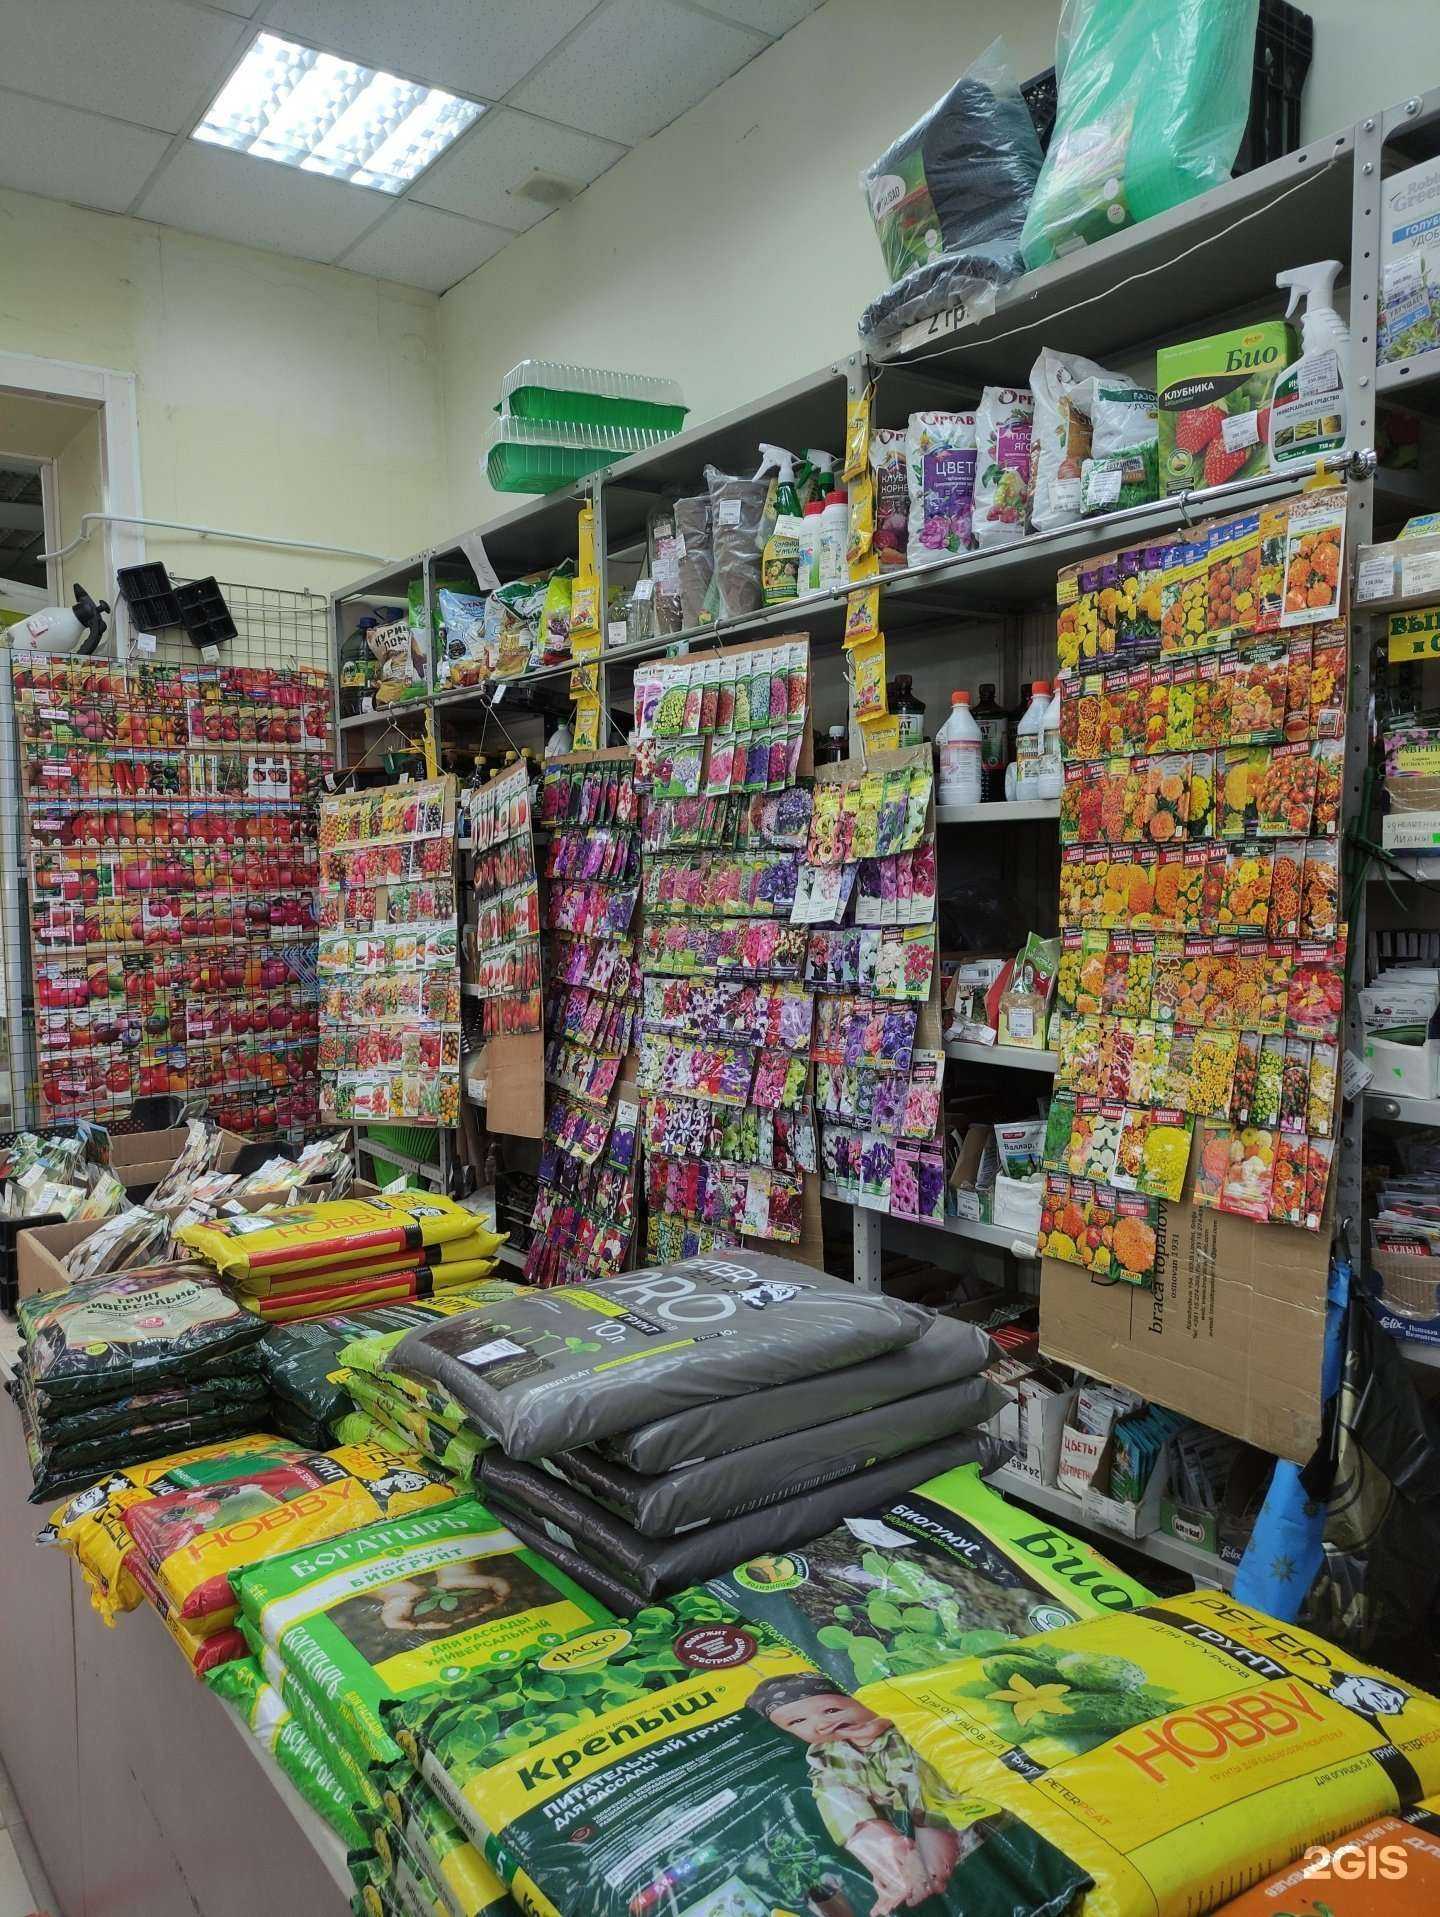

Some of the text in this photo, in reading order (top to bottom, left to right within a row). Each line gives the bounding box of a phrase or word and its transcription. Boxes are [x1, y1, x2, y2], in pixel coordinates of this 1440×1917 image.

[1224, 346, 1279, 373] Био
[1164, 381, 1215, 401] КЛУБНИКА
[277, 1210, 393, 1238] HOBBY
[1172, 1233, 1180, 1257] 1931
[117, 1291, 160, 1304] ГРУНТ
[617, 1313, 664, 1336] ГРУНТ
[187, 1479, 352, 1562] HOBBY
[290, 1512, 470, 1578] БОГАТЫРЬ
[890, 1504, 981, 1558] БИОГУМУС
[350, 1547, 463, 1588] БИОГРУНТ
[1010, 1529, 1137, 1611] Био
[424, 1618, 552, 1668] УНИВЕРСАЛЬНЫЙ
[462, 1616, 532, 1646] РАССАДЫ
[552, 1632, 617, 1664] ФАСКО
[684, 1630, 727, 1648] СОДЕРЖИТ
[1181, 1622, 1288, 1678] ГРУНТ
[1190, 1598, 1333, 1671] PETER
[517, 1691, 719, 1791] Крепыш
[1113, 1682, 1326, 1784] HOBBY
[541, 1737, 687, 1819] ПИТАТЕЛЬНЫЙ
[686, 1713, 743, 1744] ГРУНТ
[553, 1761, 660, 1832] ДЛЯ РАССАДЫ
[1042, 1776, 1112, 1828] PETERPEAT
